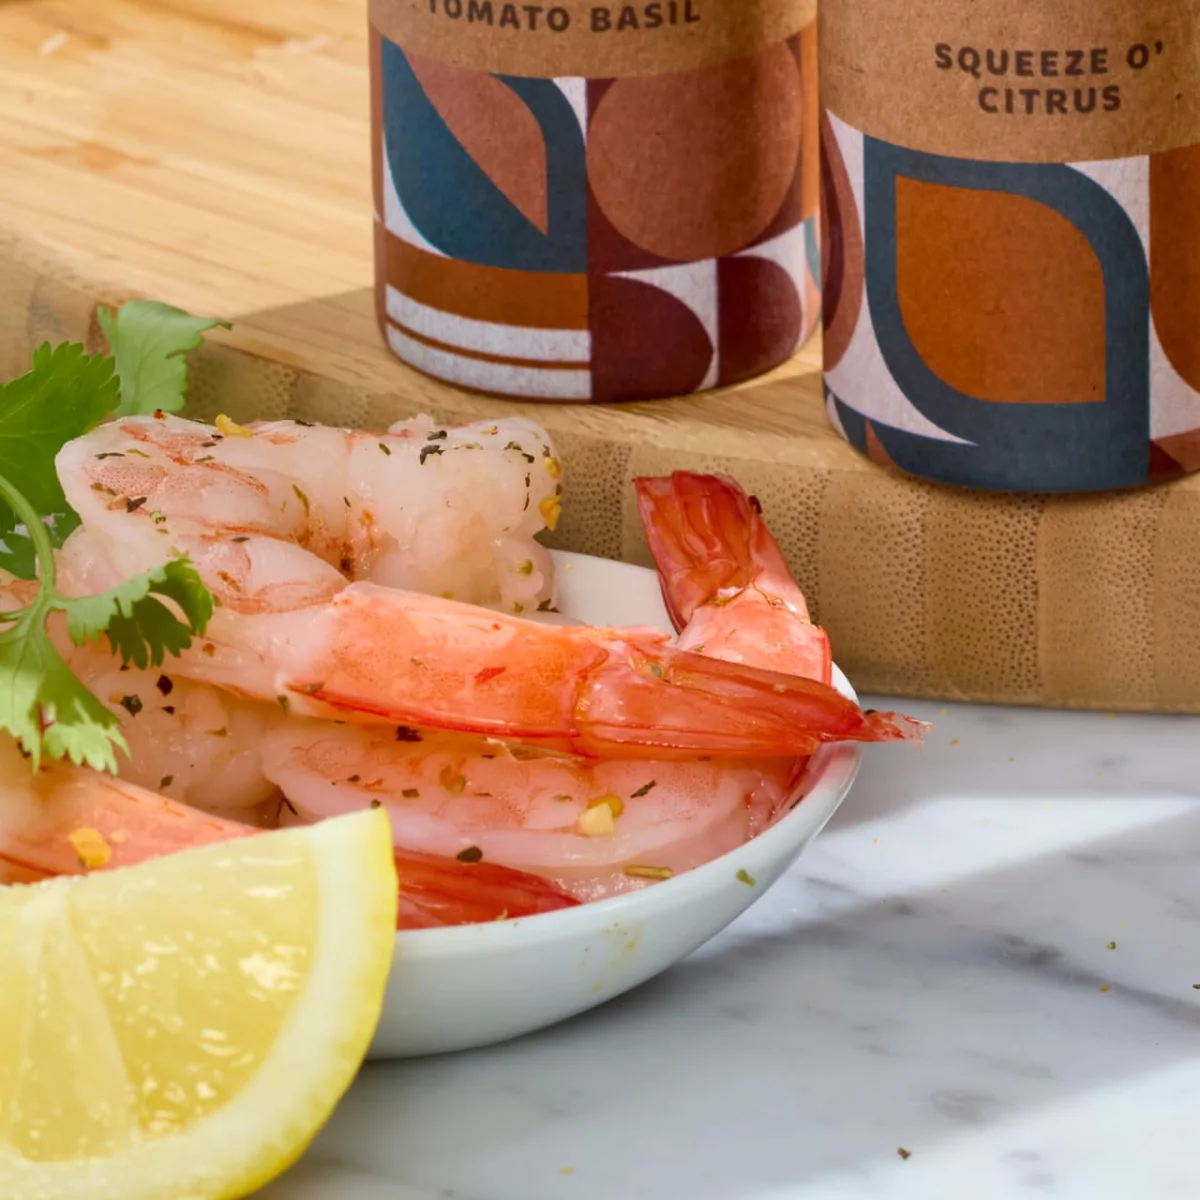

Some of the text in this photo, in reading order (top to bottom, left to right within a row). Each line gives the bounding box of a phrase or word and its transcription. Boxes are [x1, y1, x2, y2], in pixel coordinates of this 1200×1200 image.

[934, 40, 1164, 79] SQUEEZE O'
[978, 85, 1122, 115] CITRUS
